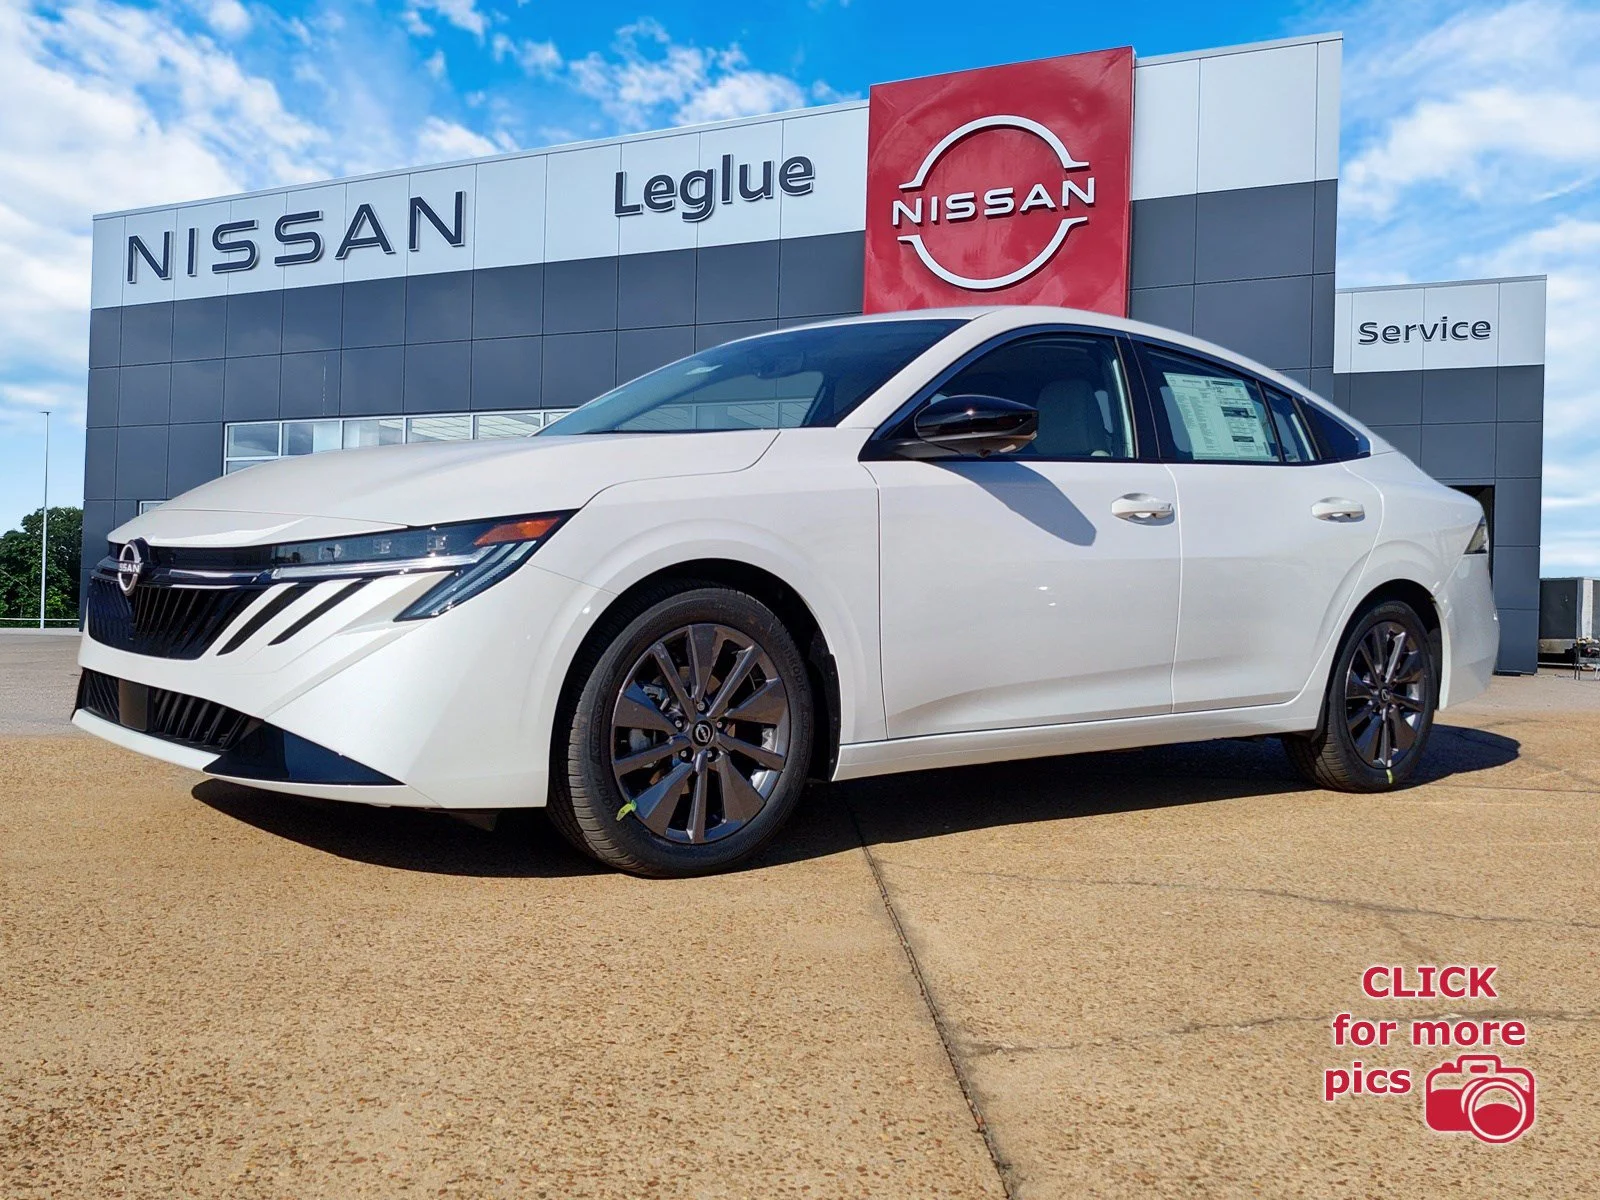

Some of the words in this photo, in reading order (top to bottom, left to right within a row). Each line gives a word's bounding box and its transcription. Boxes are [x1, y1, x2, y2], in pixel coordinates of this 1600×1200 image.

[614, 153, 815, 222] Leglue
[892, 177, 1095, 226] NISSAN
[127, 190, 466, 284] NISSAN
[1358, 316, 1492, 345] Service
